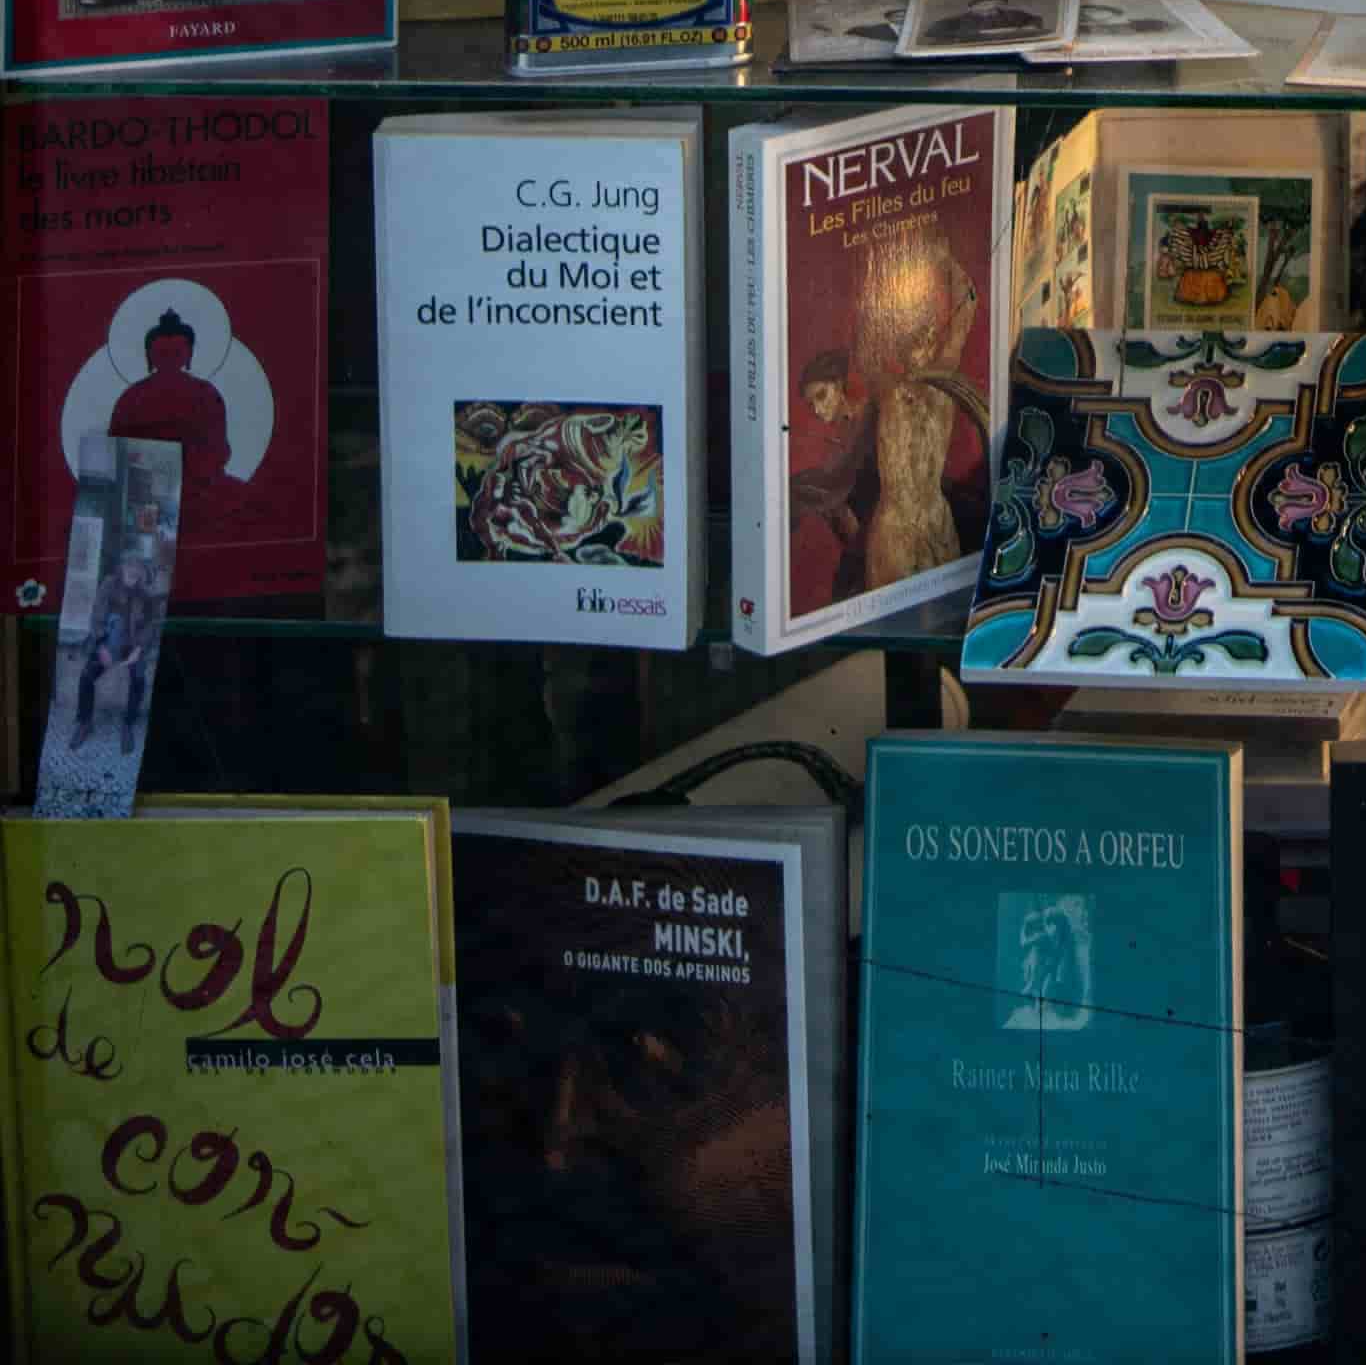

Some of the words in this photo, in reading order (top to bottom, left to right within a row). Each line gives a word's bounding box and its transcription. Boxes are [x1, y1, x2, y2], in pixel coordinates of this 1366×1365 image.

[168, 18, 237, 39] FAYARD
[801, 122, 981, 208] NERVAL
[516, 178, 582, 210] C.G.
[592, 178, 660, 216] Jung
[808, 212, 846, 238] Les
[850, 193, 905, 224] Filles
[908, 182, 935, 206] du
[940, 173, 972, 198] feu
[481, 222, 662, 257] Dialectique
[506, 261, 549, 292] du
[559, 261, 620, 291] Moi
[629, 265, 663, 291] et
[416, 296, 459, 326] de
[467, 295, 665, 328] l'inconscient
[574, 586, 616, 615] folio
[617, 594, 668, 617] essais
[904, 824, 940, 863] OS
[948, 825, 1068, 866] SONETOS
[1075, 830, 1096, 866] A
[1099, 829, 1187, 870] ORFEU
[584, 875, 651, 909] D.A.F.
[656, 884, 687, 913] de
[690, 885, 750, 917] Sade
[654, 921, 750, 964] MINSKI,
[575, 950, 641, 975] GIGANTE
[642, 958, 672, 976] DOS
[674, 962, 752, 985] APENINOS
[951, 1057, 1018, 1093] Rainer
[1023, 1059, 1081, 1094] Maria
[1086, 1061, 1140, 1095] Rilke
